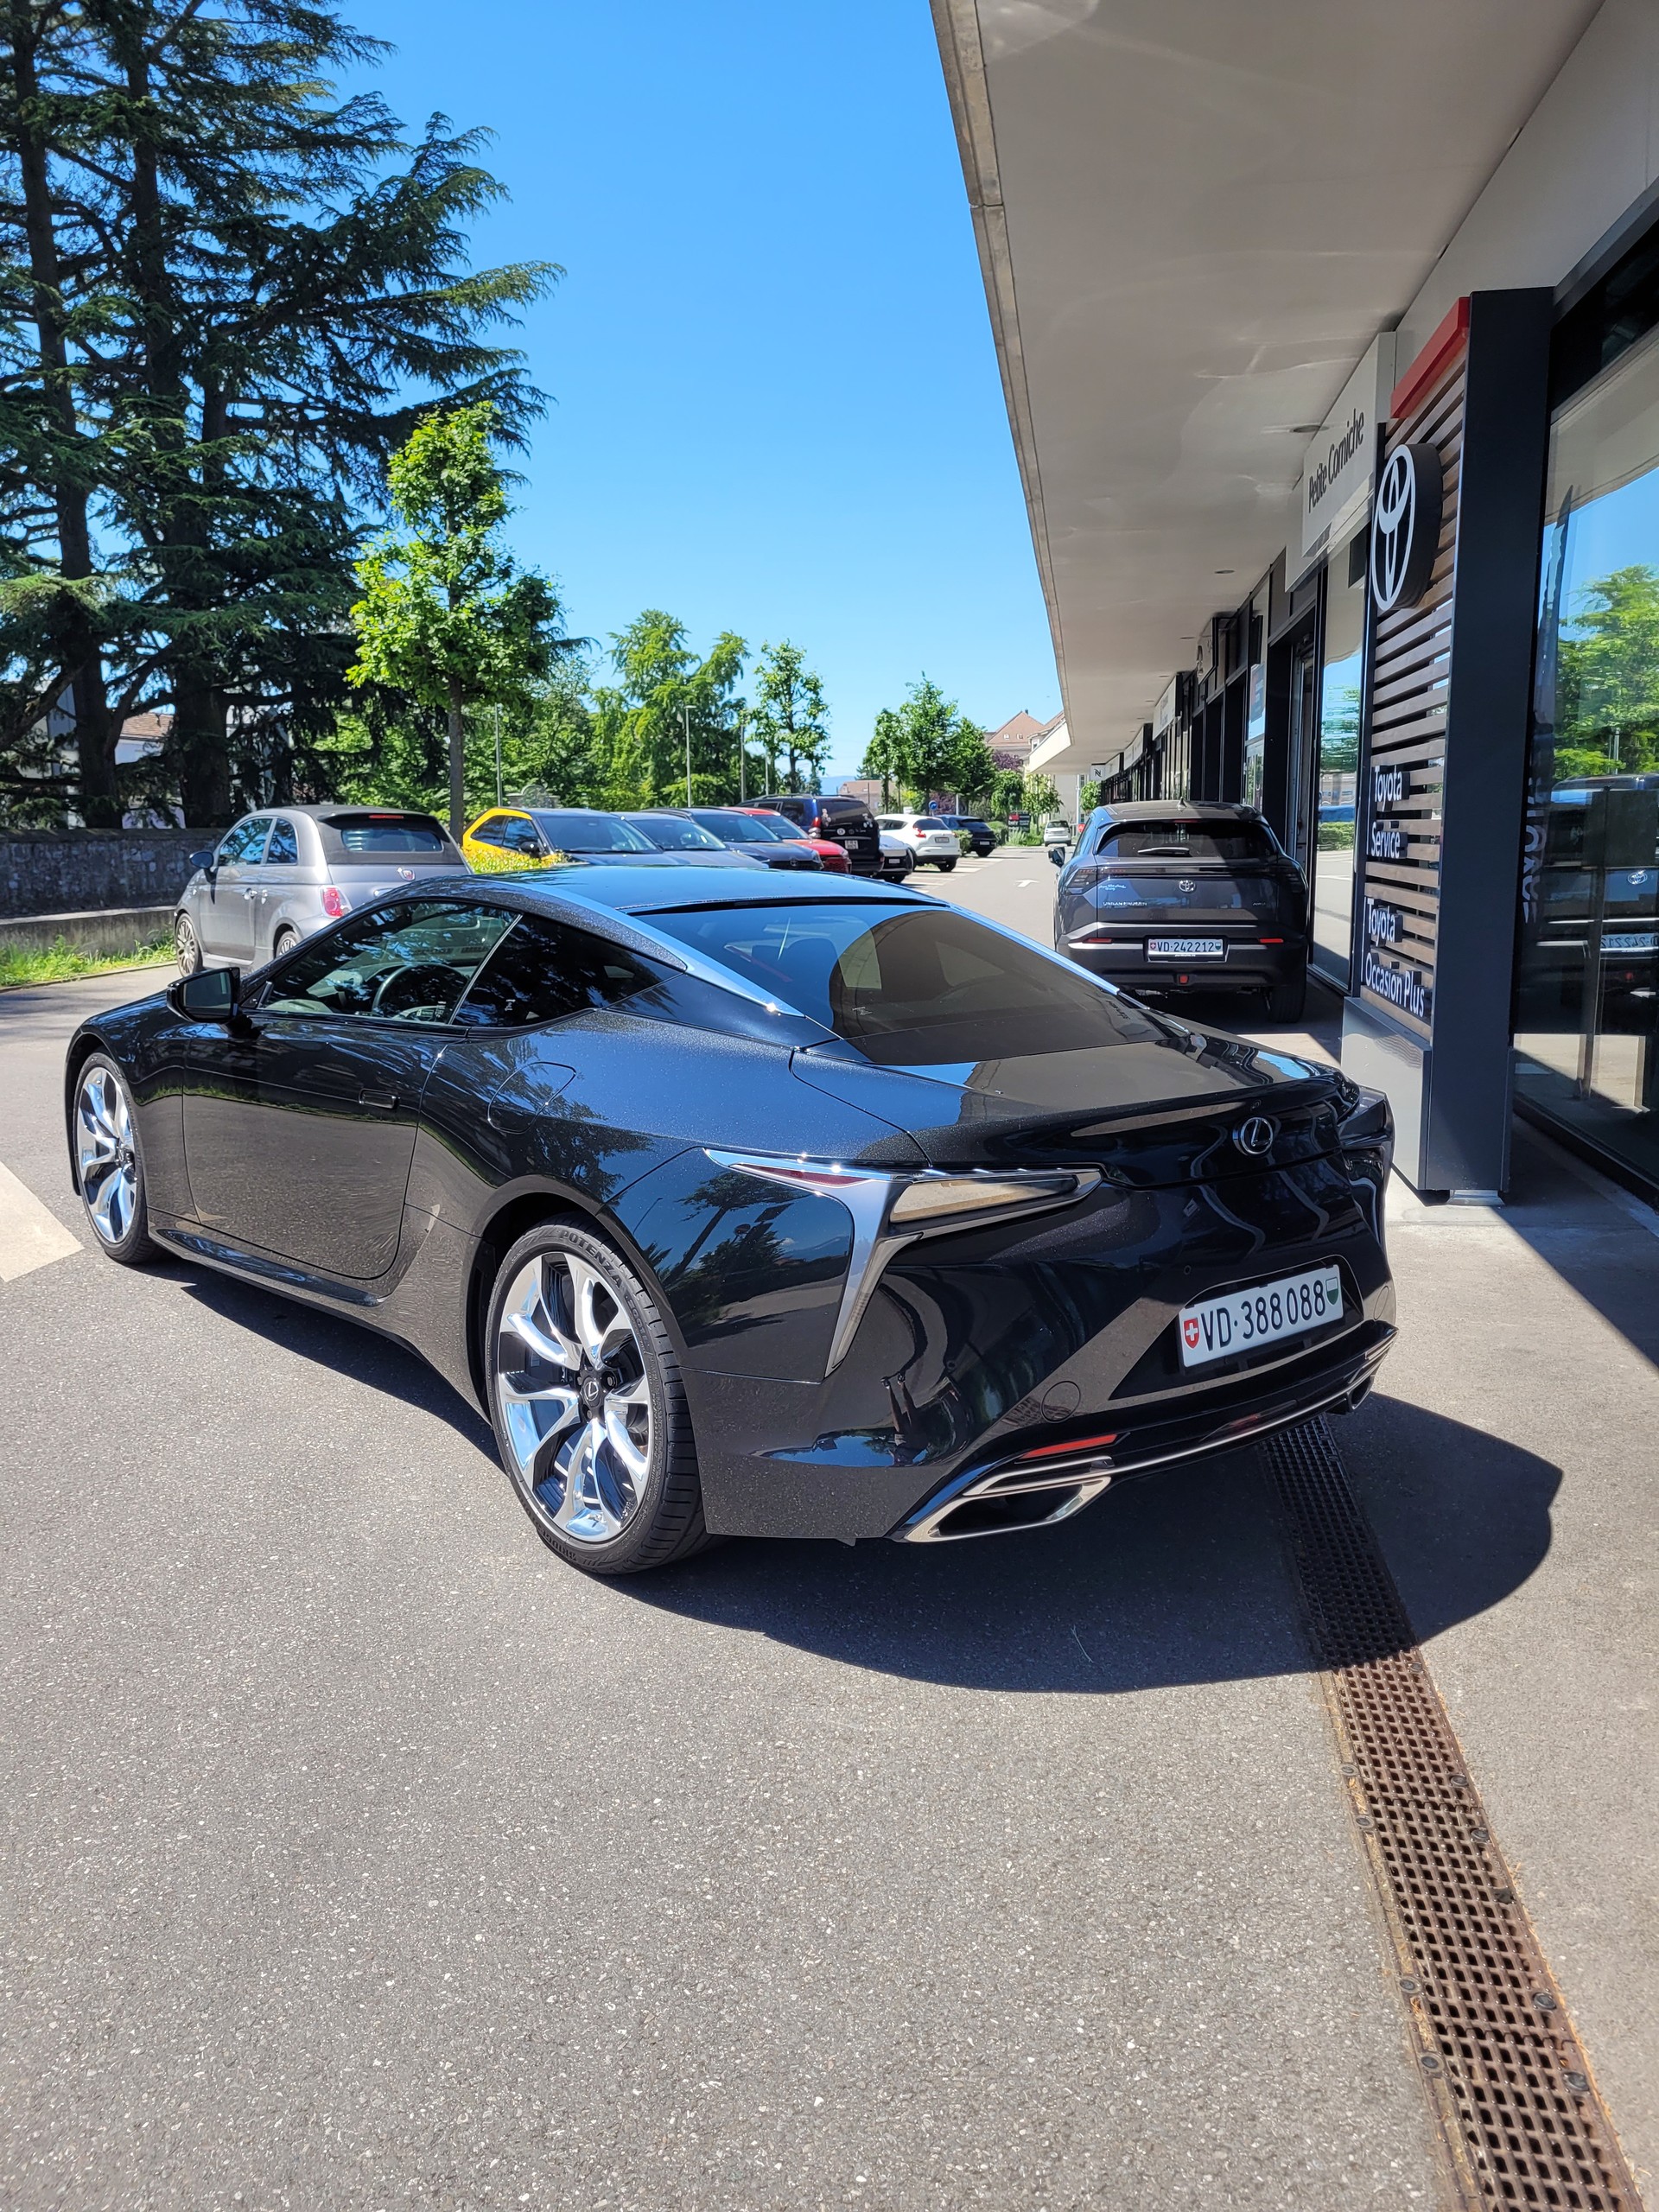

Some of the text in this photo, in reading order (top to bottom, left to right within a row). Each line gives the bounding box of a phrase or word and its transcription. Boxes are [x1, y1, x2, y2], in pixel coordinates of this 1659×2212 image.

[1308, 408, 1364, 513] Petite Corniche
[1375, 765, 1402, 812] Toyota
[1371, 821, 1400, 858] Service
[1367, 898, 1395, 947] Toyota
[1365, 952, 1425, 1017] Occasion Plus
[560, 1229, 623, 1289] POTENZA
